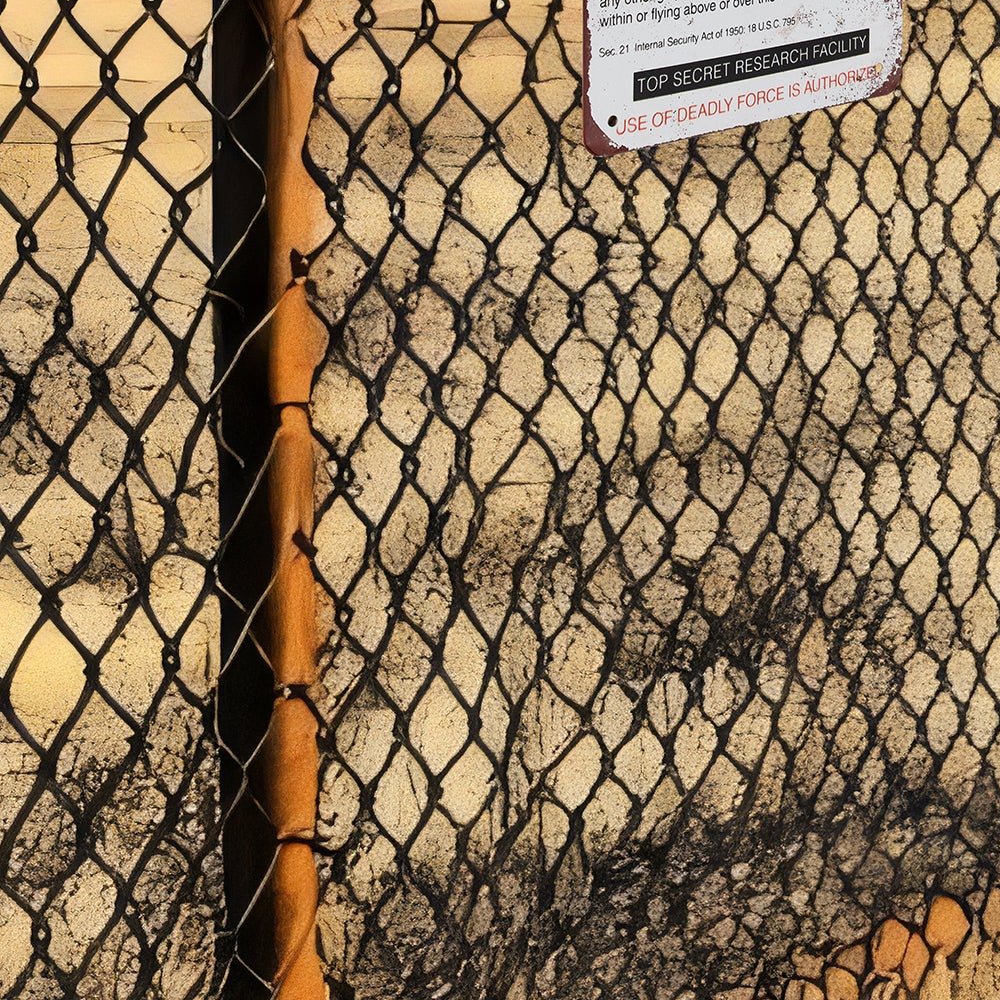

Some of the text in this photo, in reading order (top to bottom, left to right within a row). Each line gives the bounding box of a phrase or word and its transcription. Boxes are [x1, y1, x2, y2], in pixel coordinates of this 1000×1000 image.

[599, 12, 633, 27] within
[636, 12, 649, 23] or
[651, 7, 681, 22] flying
[683, 1, 717, 15] above
[619, 44, 630, 55] 21
[634, 40, 666, 52] Internal
[667, 34, 700, 47] Security
[700, 31, 714, 42] Act
[715, 28, 724, 39] of
[748, 23, 757, 33] 18
[637, 35, 867, 93] TOP SECRET RESEARCH FACILITY
[651, 110, 674, 128] OF
[677, 97, 733, 123] DEADLY
[737, 86, 785, 110] FORCE
[788, 83, 801, 98] IS
